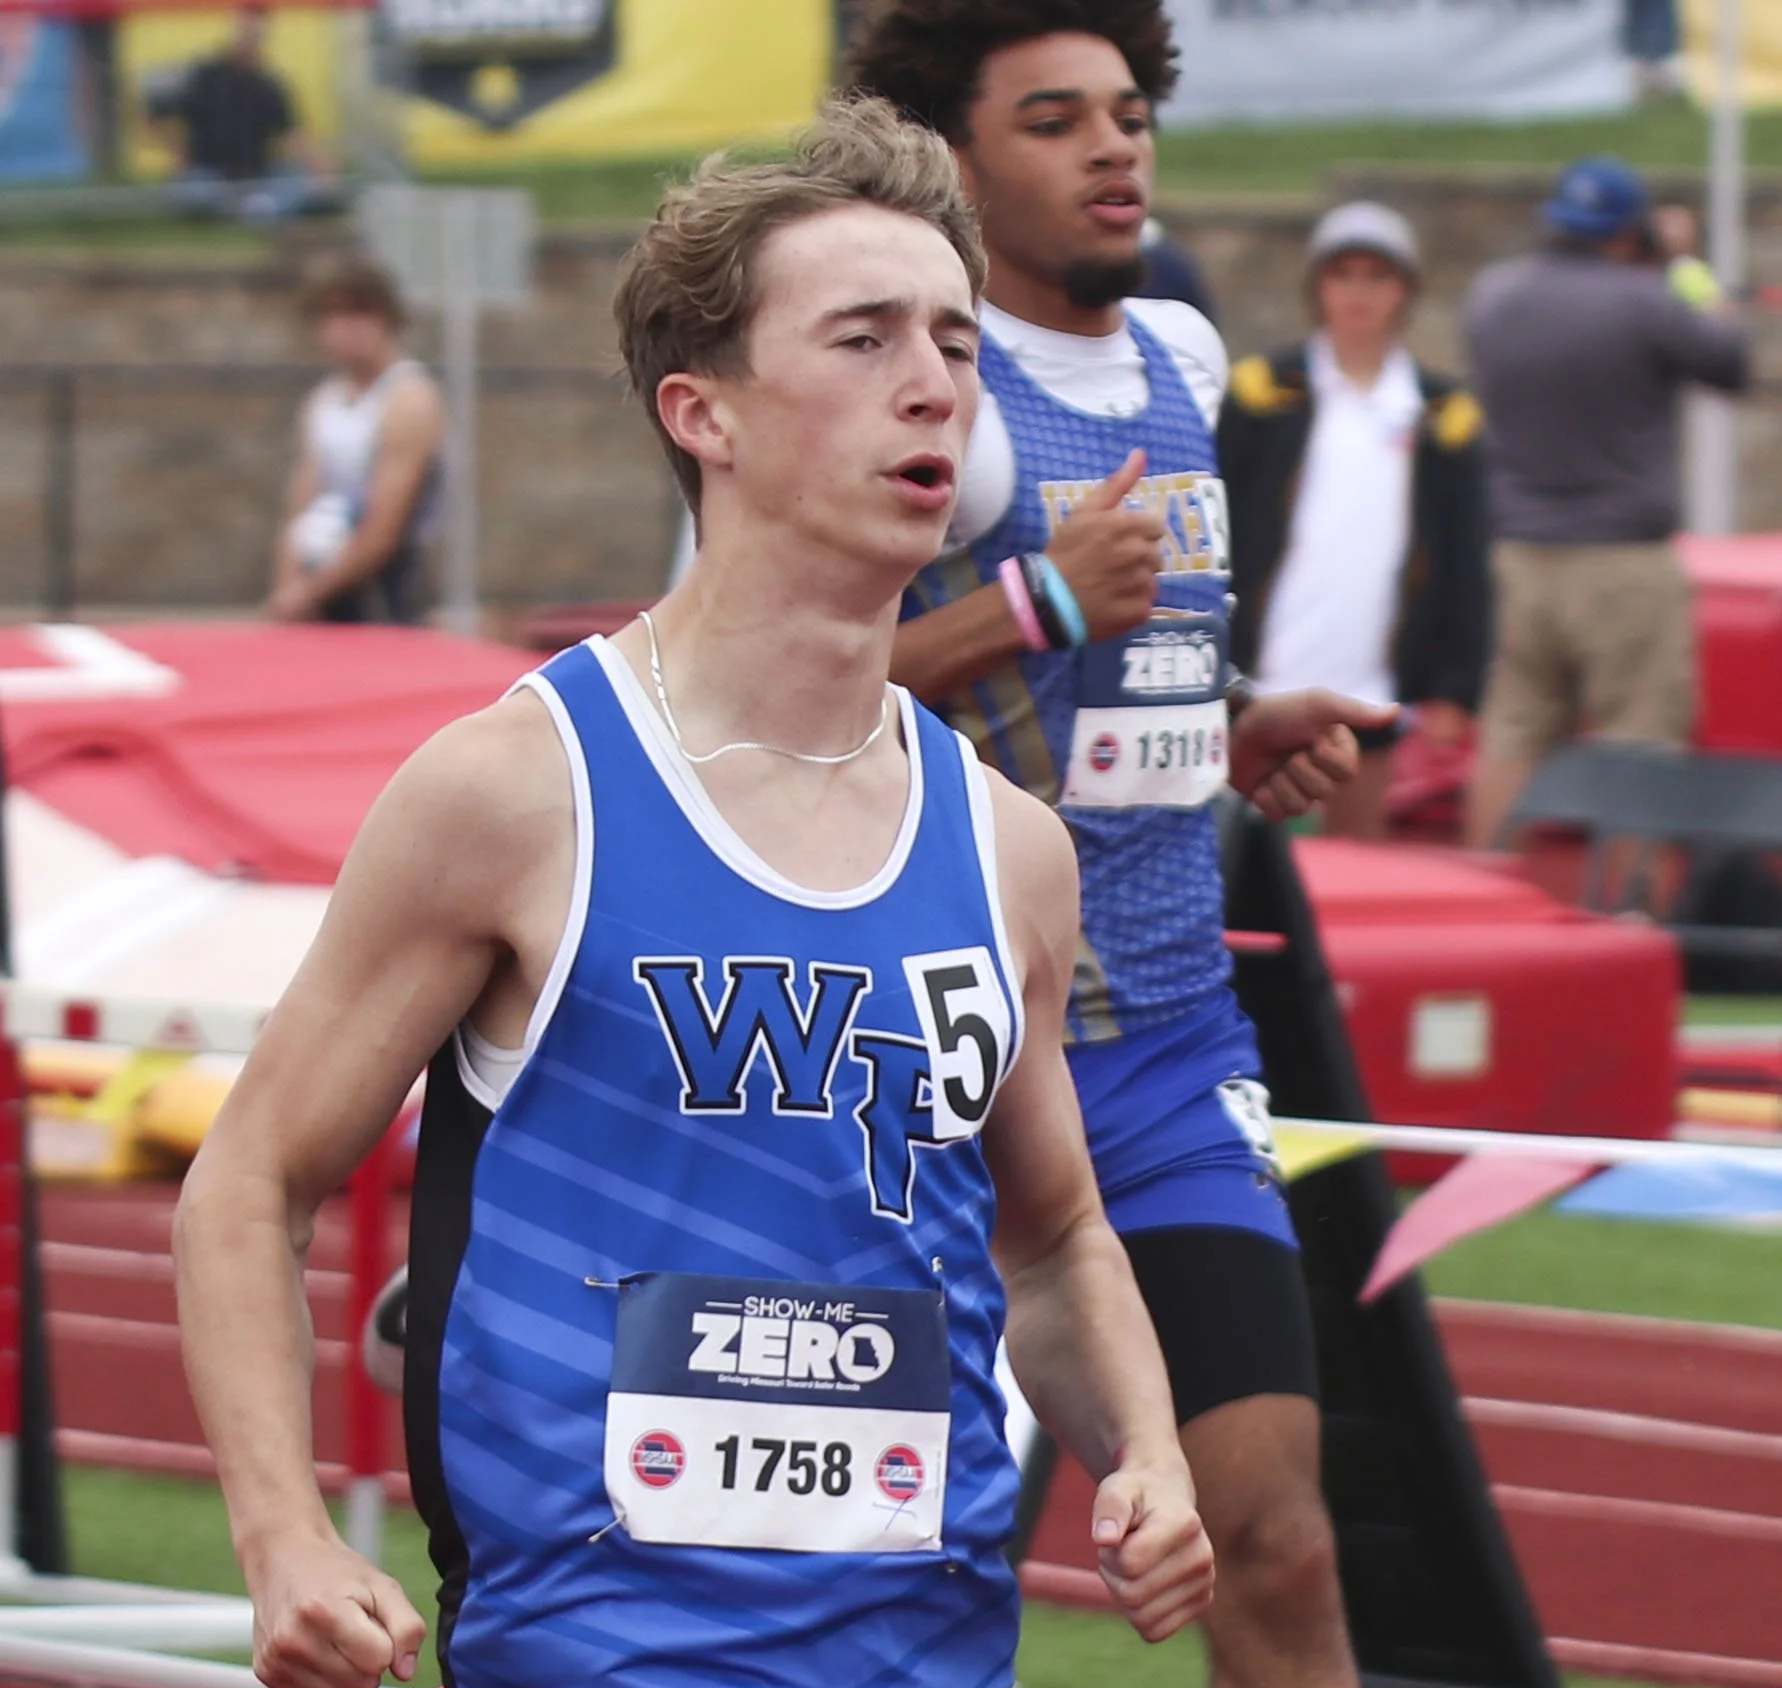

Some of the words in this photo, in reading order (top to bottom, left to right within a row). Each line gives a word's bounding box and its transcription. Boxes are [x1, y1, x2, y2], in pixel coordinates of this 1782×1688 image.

[1121, 642, 1217, 688] ZERO
[922, 963, 998, 1122] 5
[744, 1296, 857, 1323] SHOW-ME
[688, 1312, 895, 1383] ZERO
[715, 1434, 853, 1497] 1758
